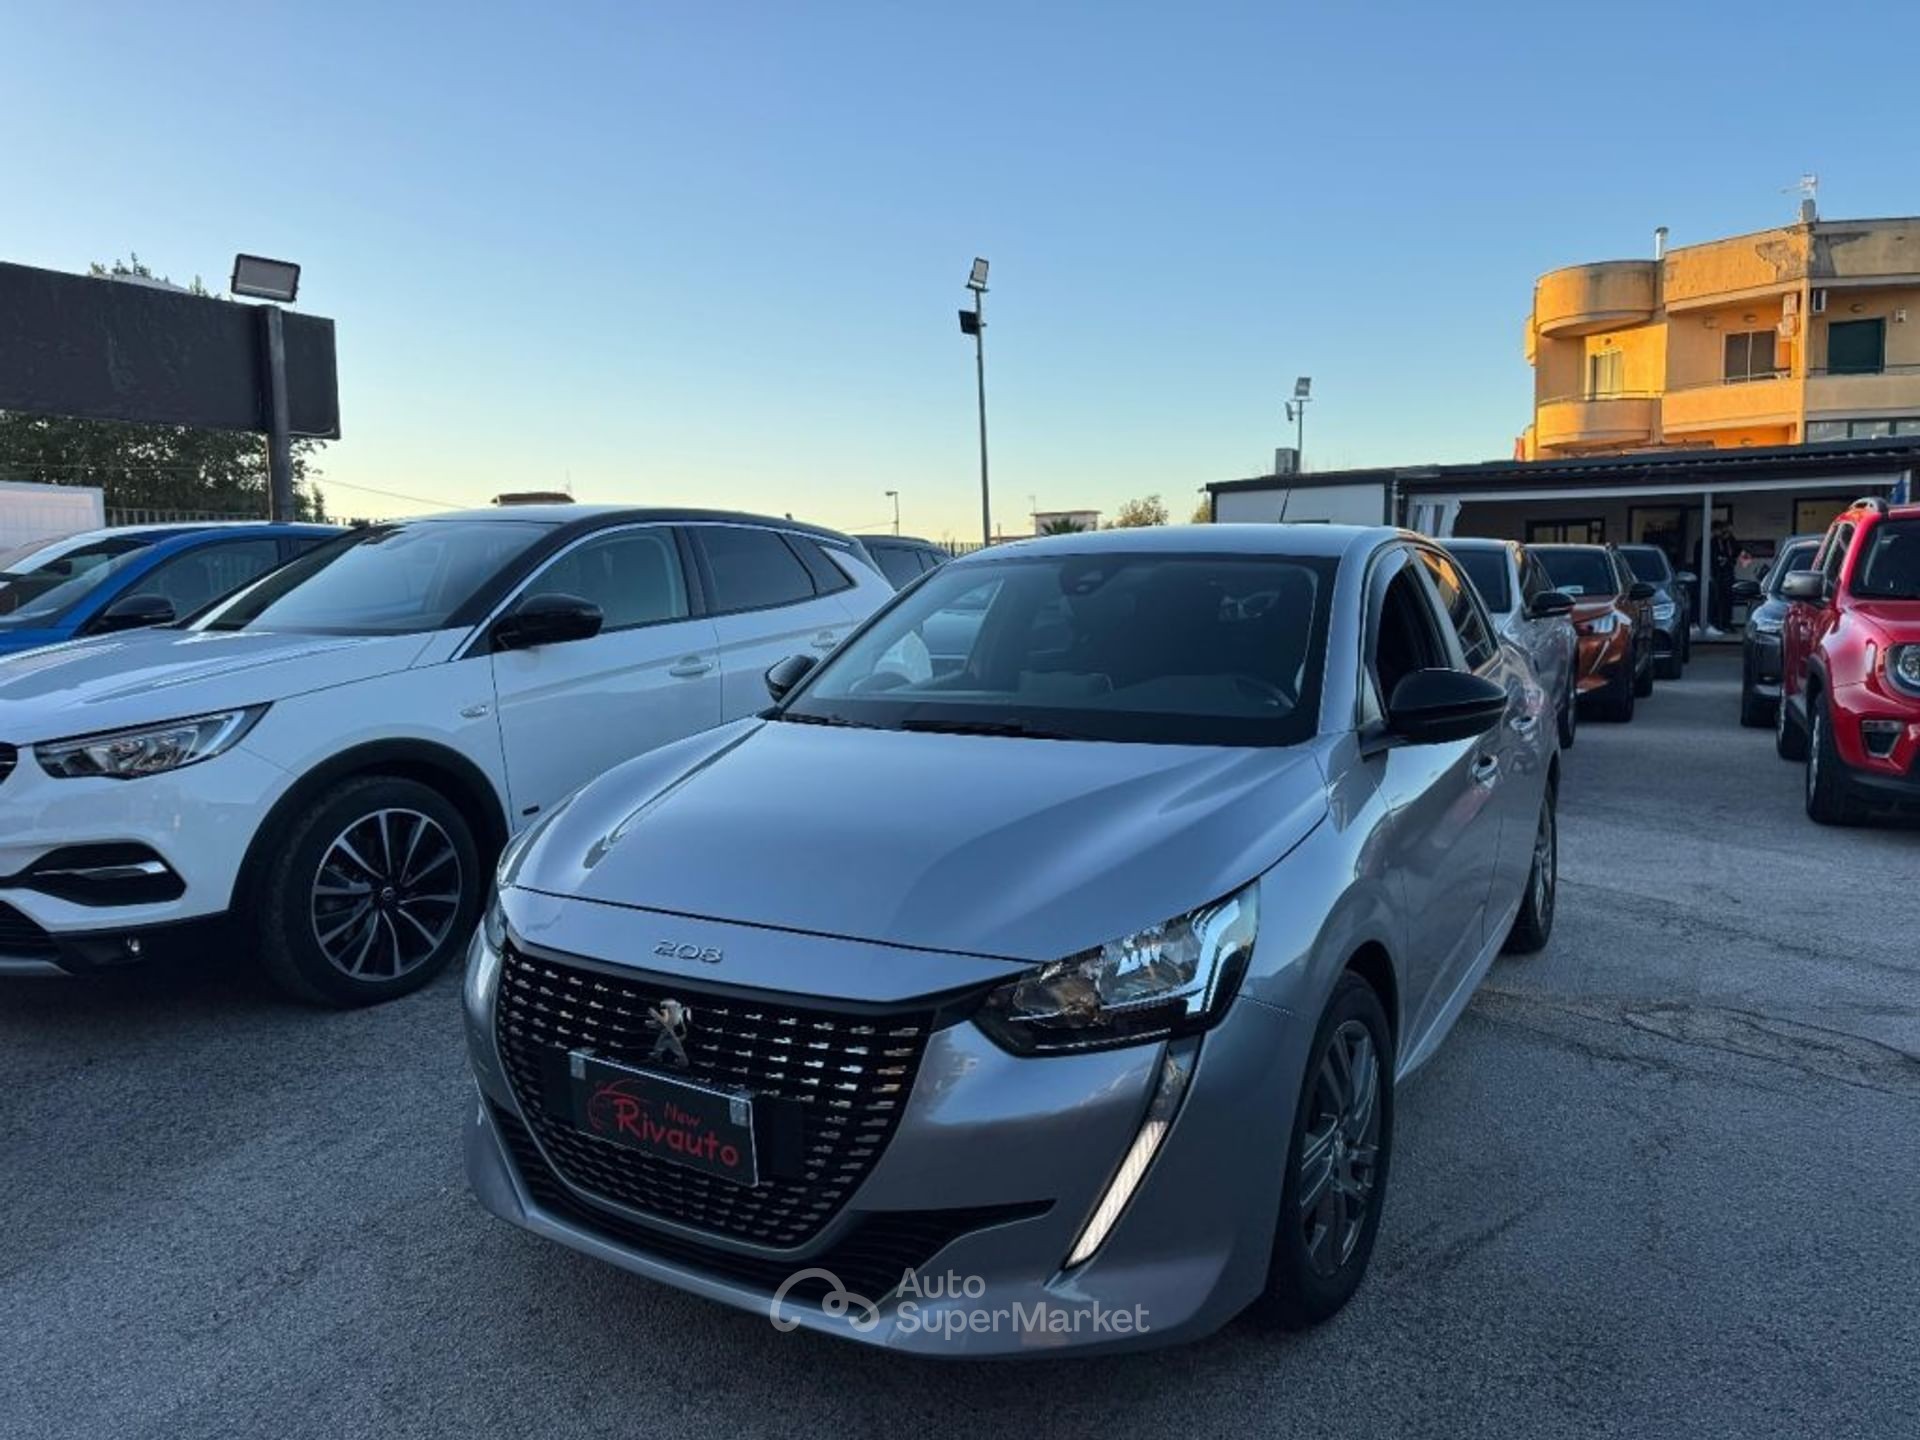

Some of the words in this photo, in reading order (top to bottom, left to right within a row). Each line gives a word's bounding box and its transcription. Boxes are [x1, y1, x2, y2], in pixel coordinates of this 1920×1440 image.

[654, 940, 723, 963] 208
[664, 1101, 703, 1127] New
[613, 1098, 740, 1167] Rivauto
